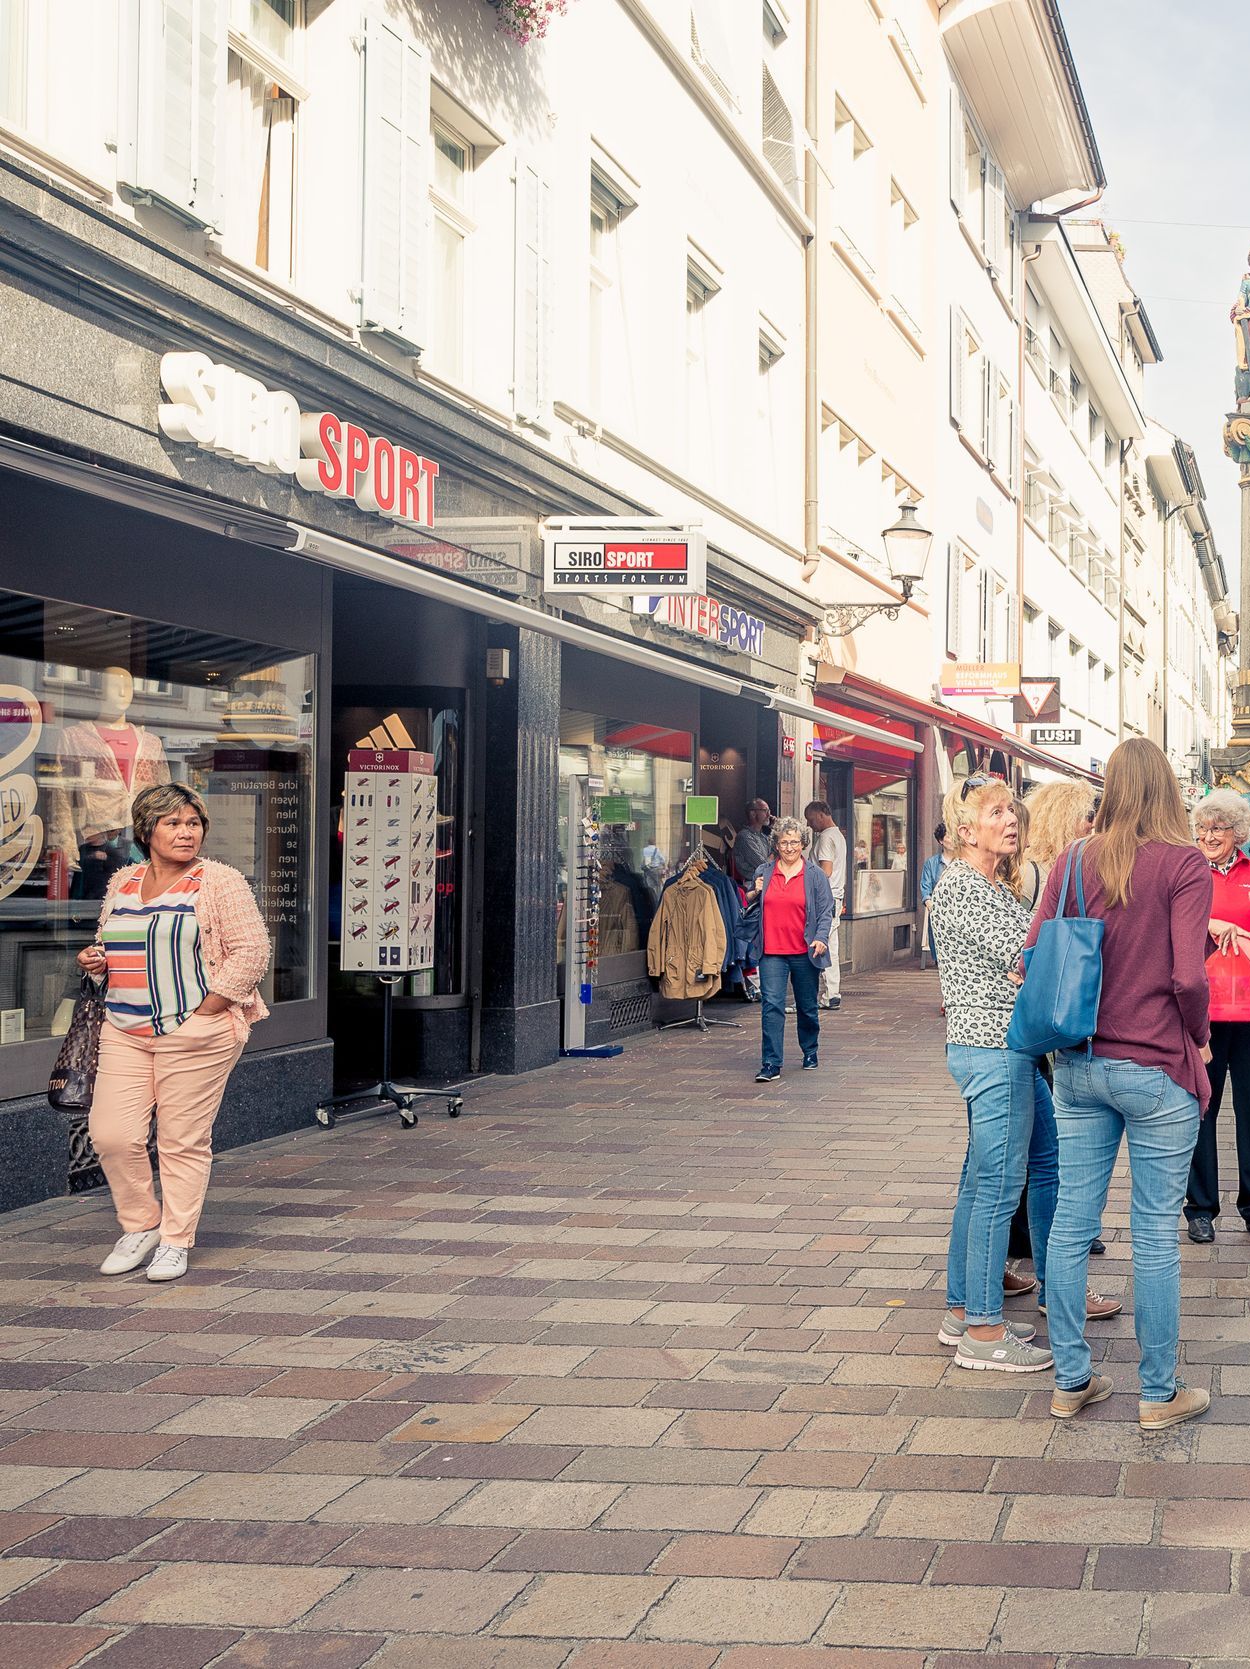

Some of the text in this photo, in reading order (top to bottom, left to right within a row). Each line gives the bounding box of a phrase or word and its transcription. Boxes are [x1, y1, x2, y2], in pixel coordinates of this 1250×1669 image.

[310, 411, 440, 529] SPORT
[568, 551, 655, 568] SIRO SPORT
[556, 573, 686, 583] SPORTS FOR FUN
[667, 594, 765, 656] INTERSPORT
[1036, 730, 1076, 741] LUSH
[700, 763, 735, 771] ICTORINOX
